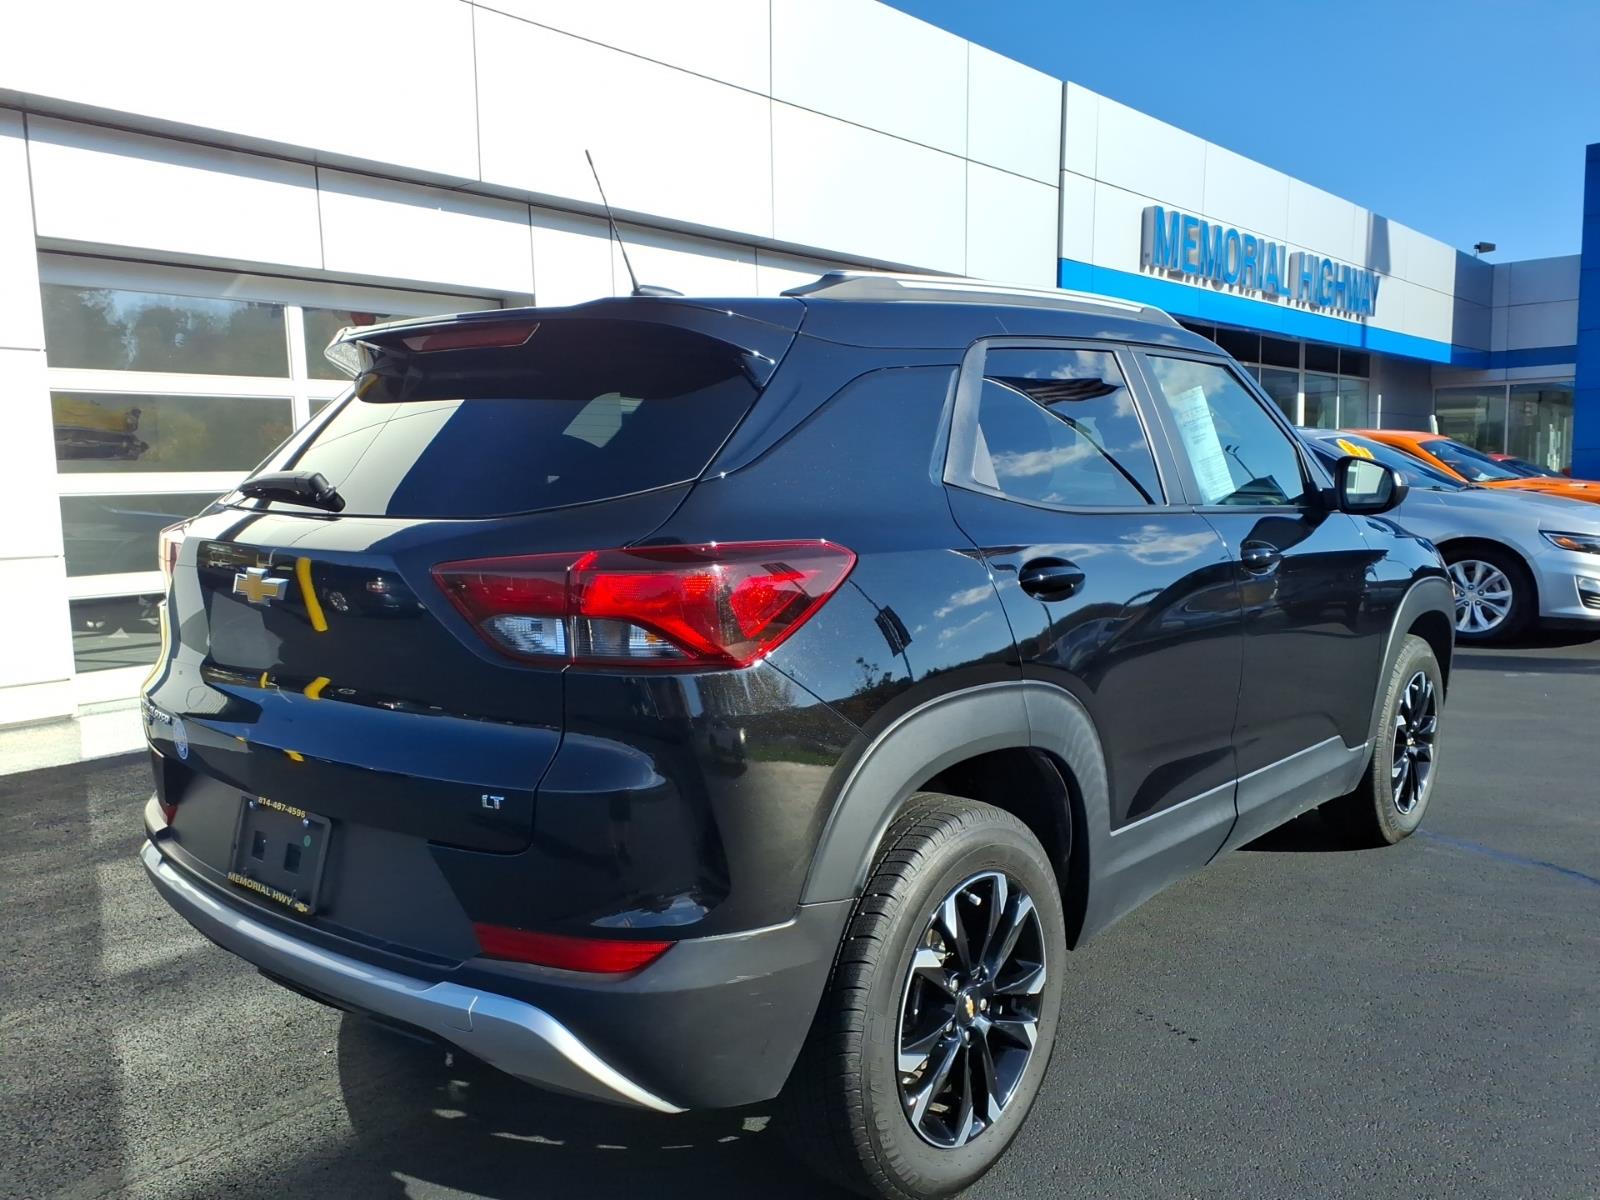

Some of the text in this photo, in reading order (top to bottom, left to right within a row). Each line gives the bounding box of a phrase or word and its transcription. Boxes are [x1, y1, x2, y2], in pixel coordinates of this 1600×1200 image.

[1141, 205, 1381, 318] MEMORIAL HIGHWAY
[481, 794, 505, 810] LT
[228, 872, 293, 906] MEMORIAL HWY
